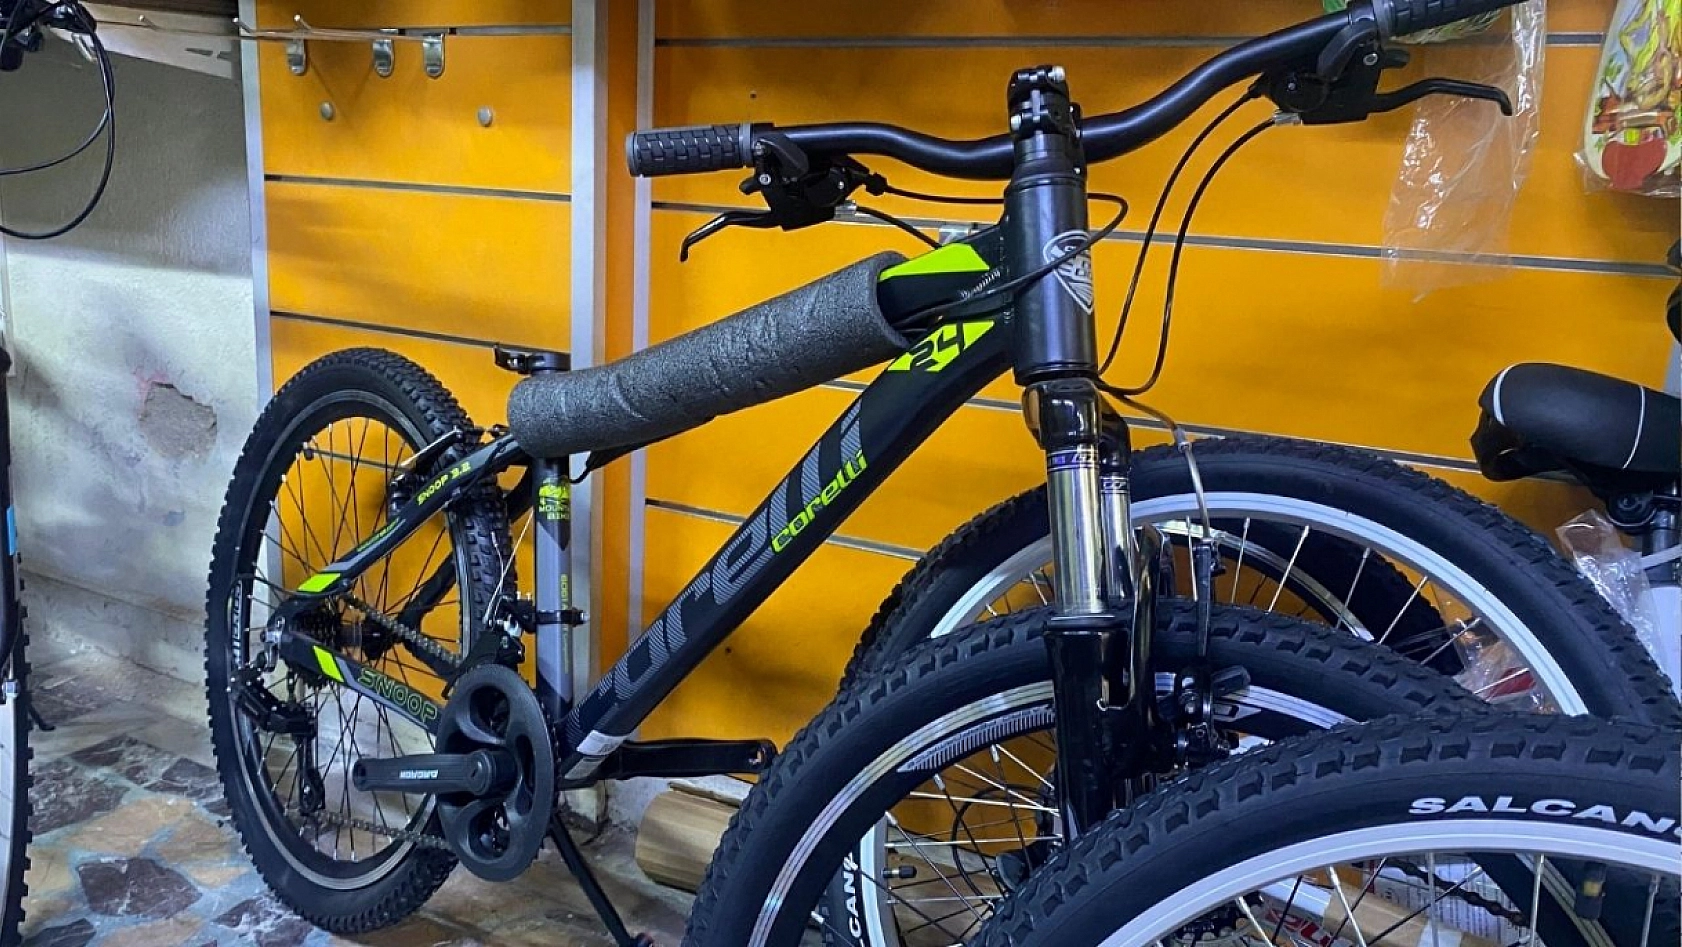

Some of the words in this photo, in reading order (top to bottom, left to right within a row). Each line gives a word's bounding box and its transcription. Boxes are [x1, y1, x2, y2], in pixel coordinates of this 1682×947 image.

[910, 322, 965, 372] 24
[771, 449, 868, 553] corelli
[358, 667, 438, 722] SNOOP
[1408, 796, 1681, 837] SALCAN
